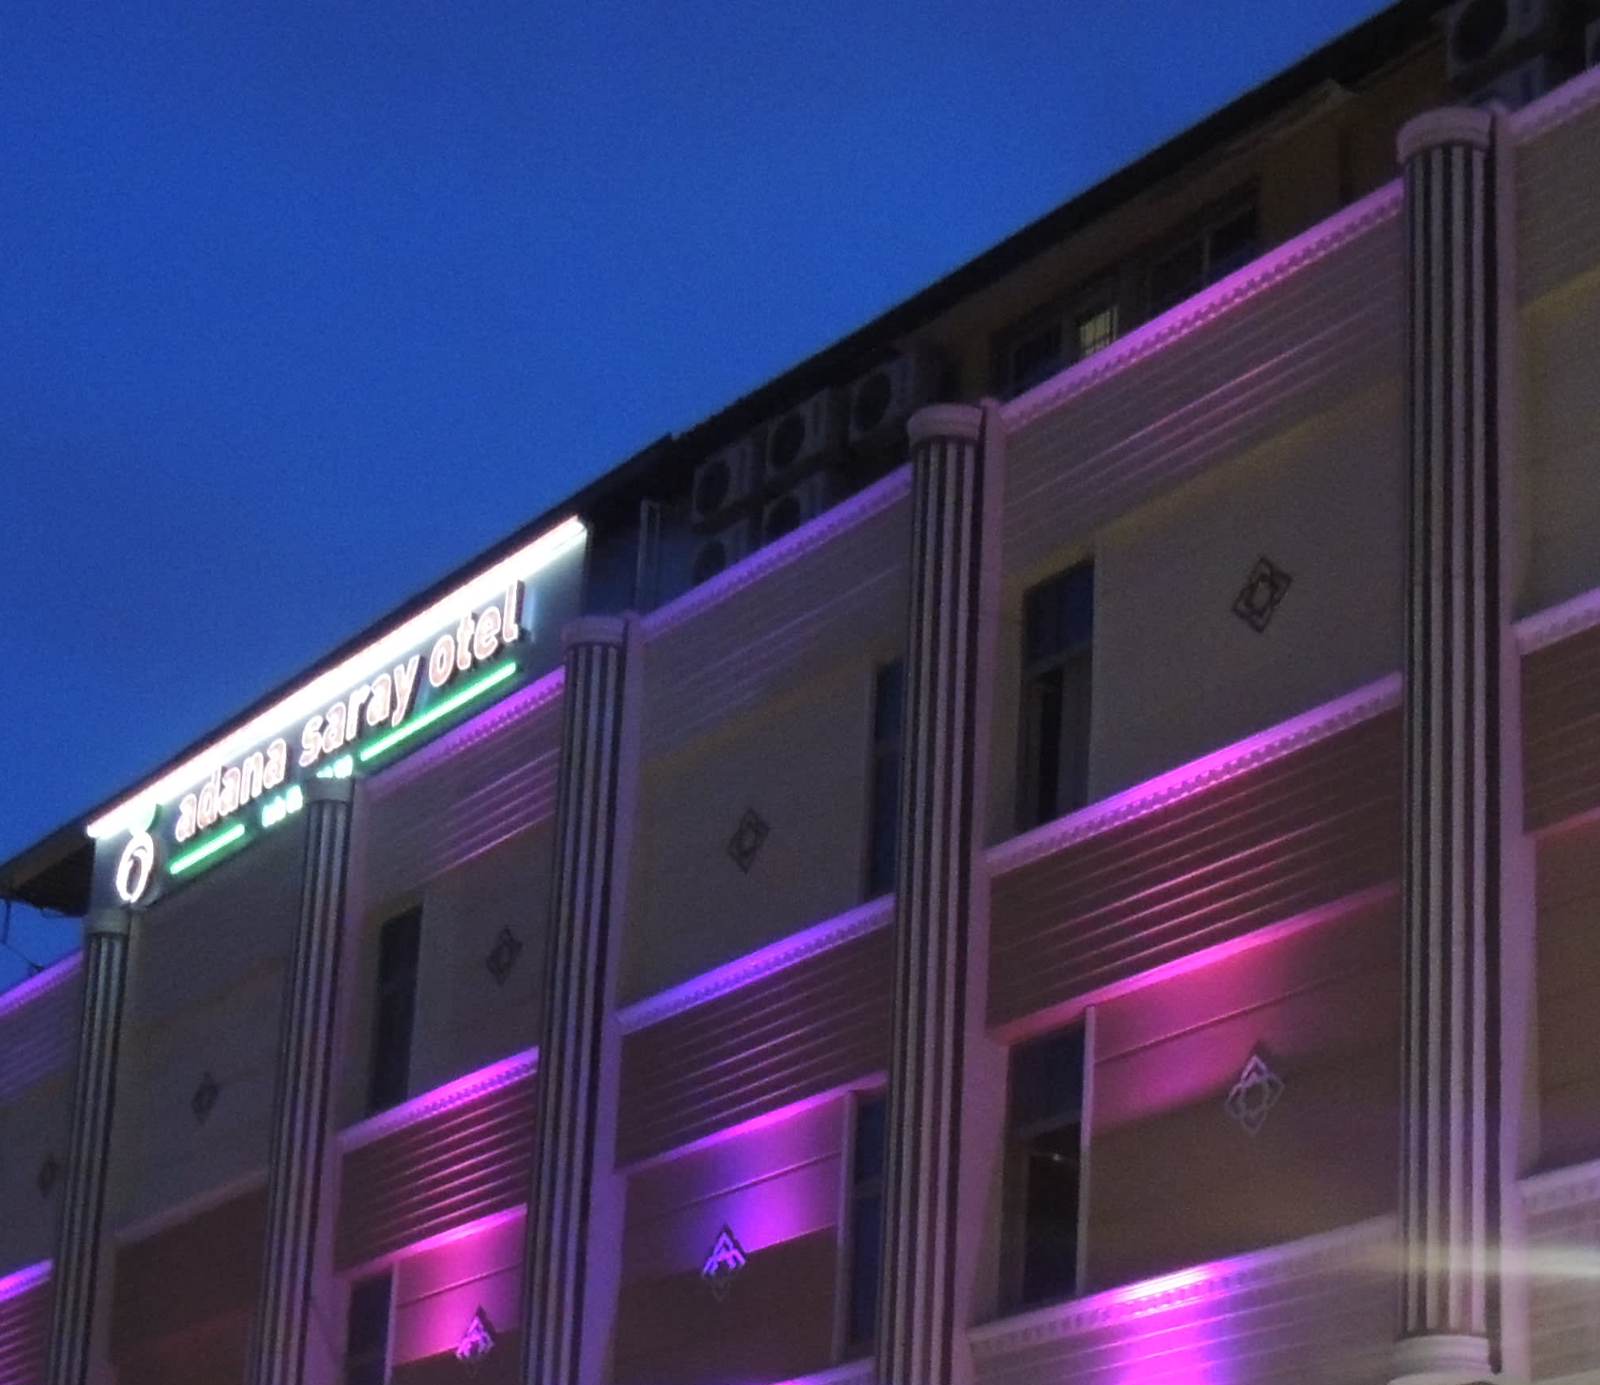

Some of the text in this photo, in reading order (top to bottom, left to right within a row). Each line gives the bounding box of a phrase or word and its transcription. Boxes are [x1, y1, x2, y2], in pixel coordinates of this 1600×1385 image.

[174, 579, 521, 843] adana saray otel
